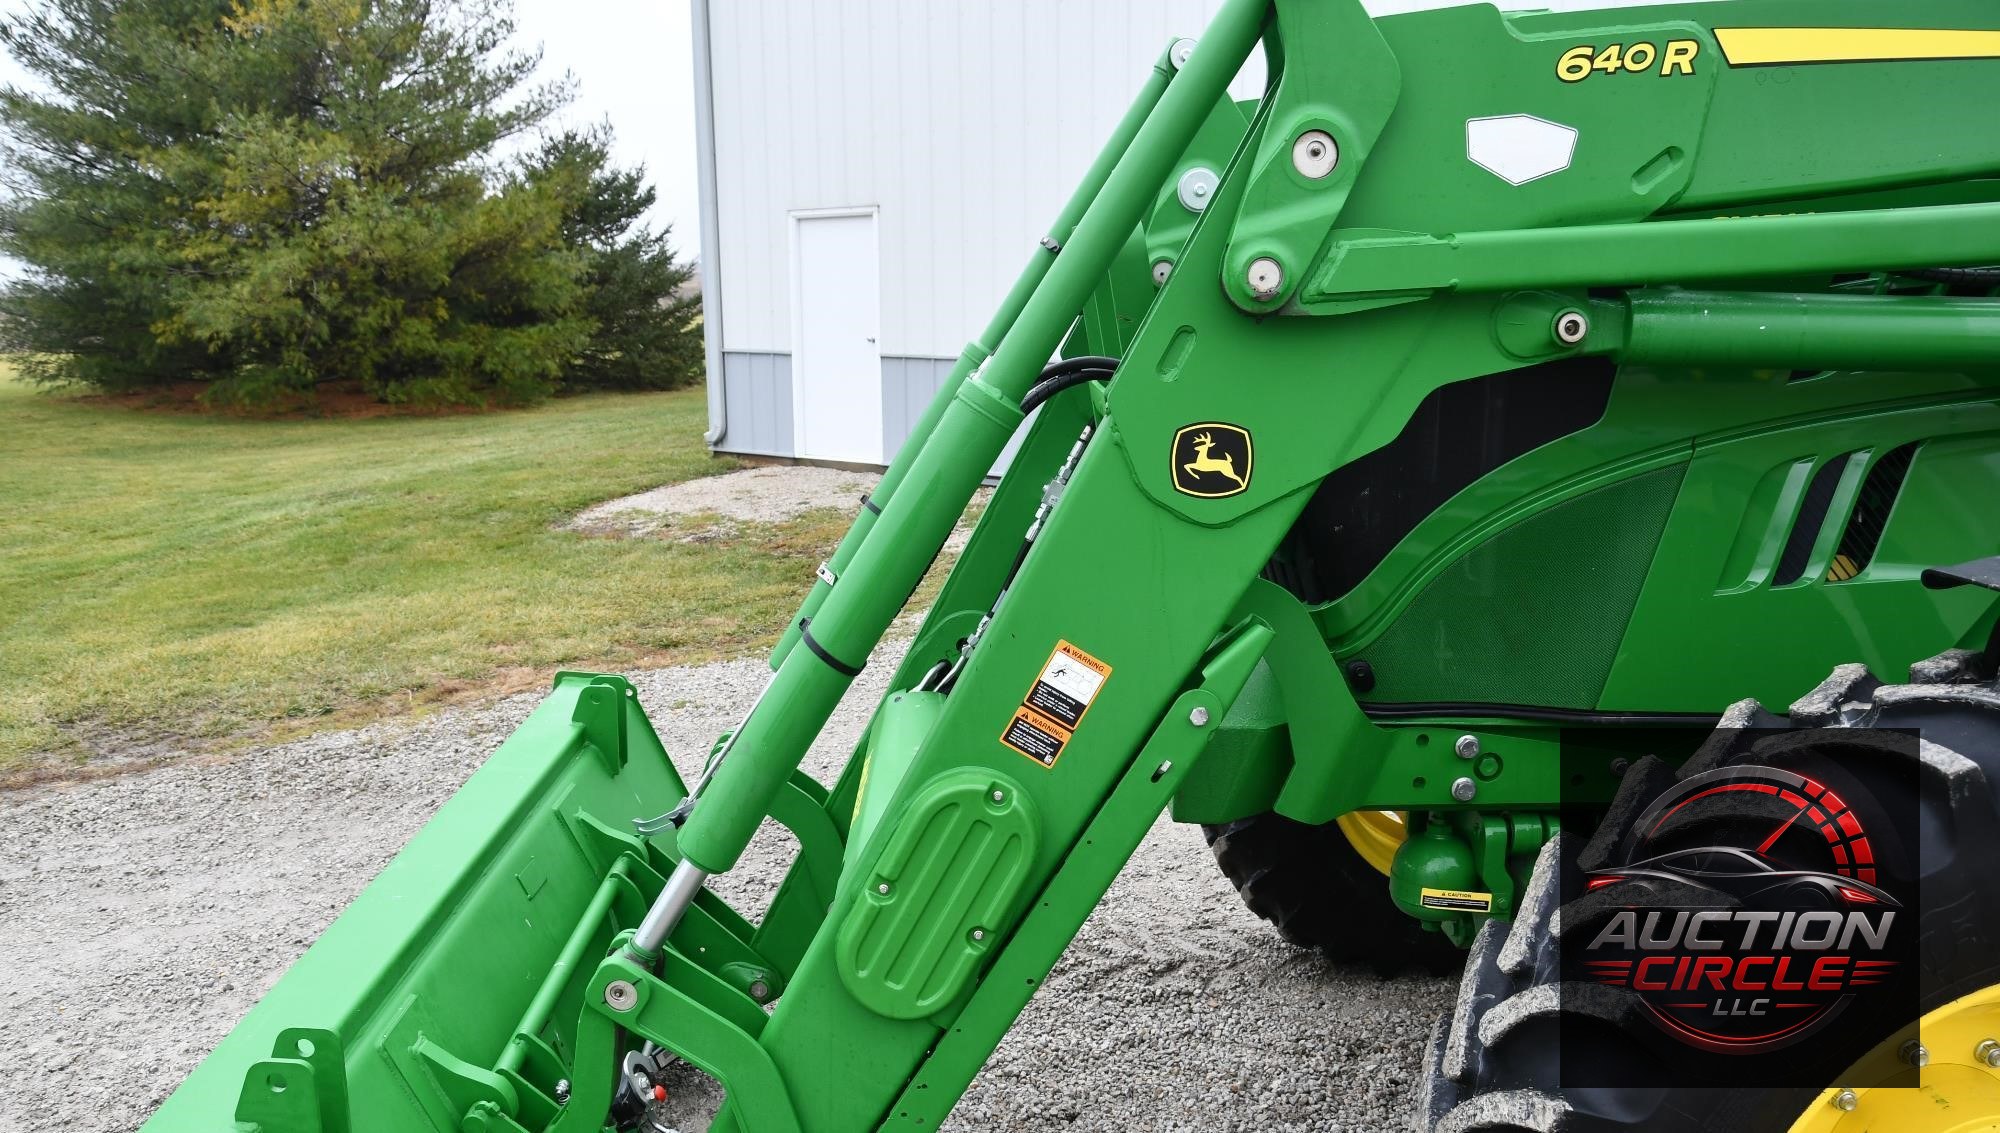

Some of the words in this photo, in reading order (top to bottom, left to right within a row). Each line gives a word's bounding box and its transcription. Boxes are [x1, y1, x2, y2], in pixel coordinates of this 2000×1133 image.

[1071, 650, 1105, 672] WARNING
[1031, 716, 1064, 739] WARNING
[1447, 891, 1472, 899] CAUTION
